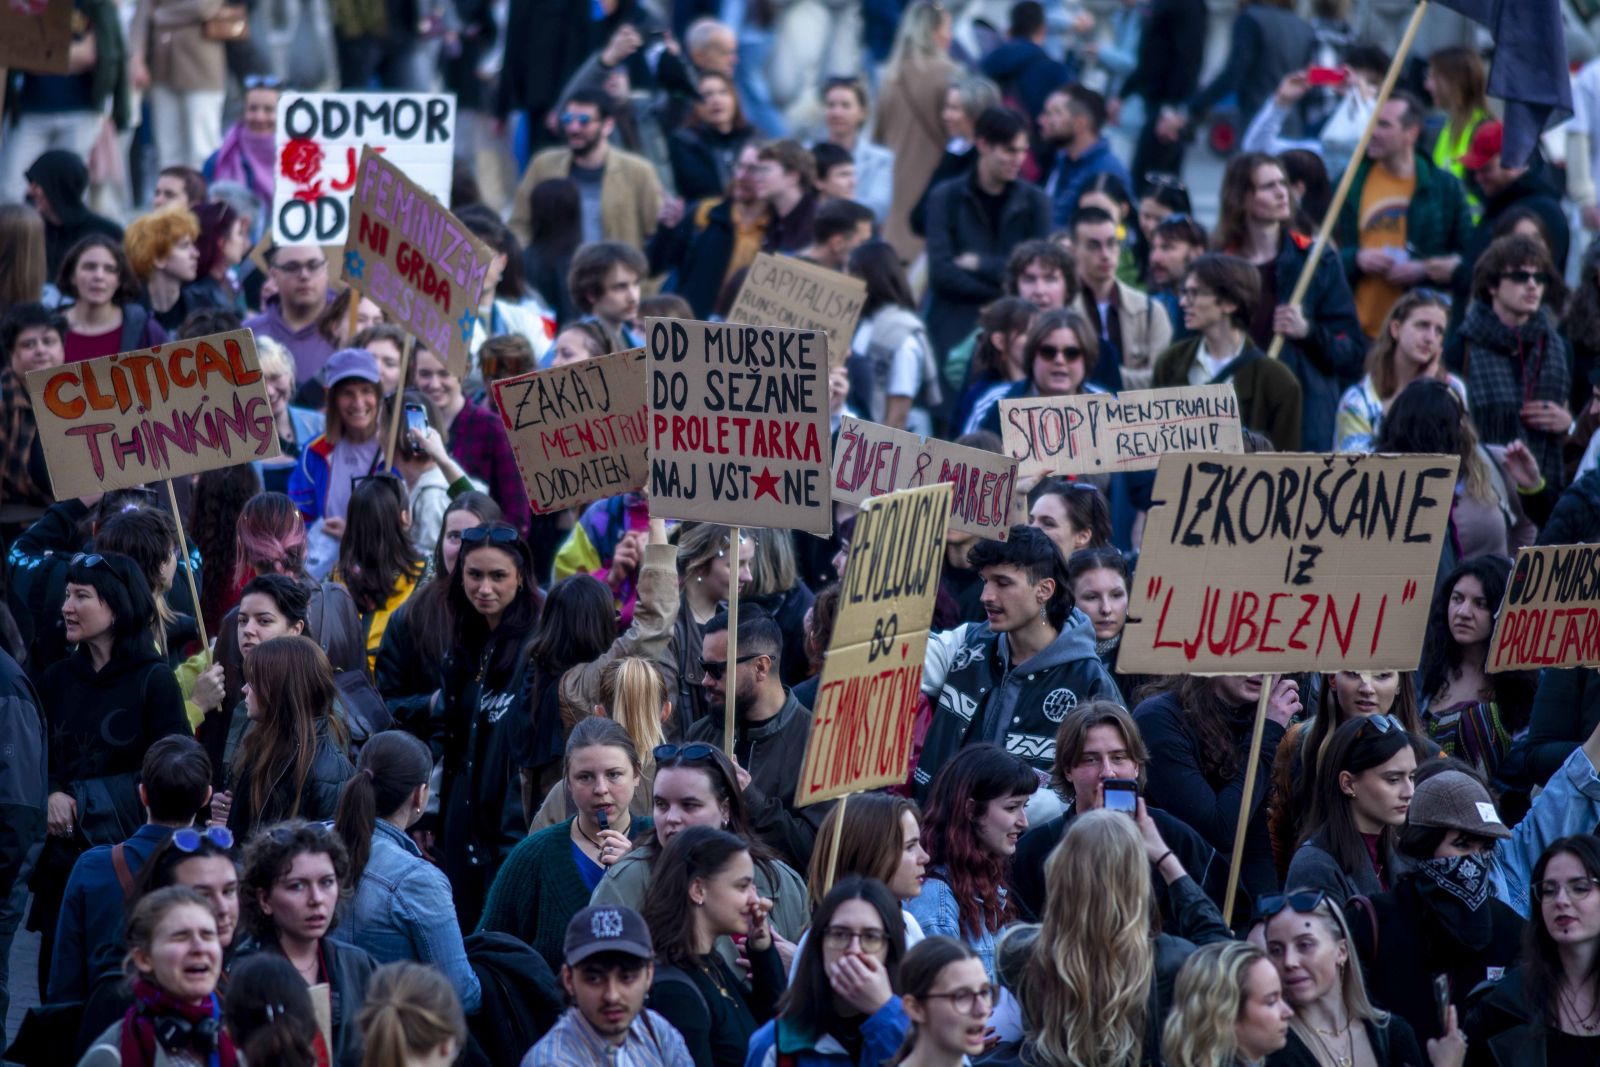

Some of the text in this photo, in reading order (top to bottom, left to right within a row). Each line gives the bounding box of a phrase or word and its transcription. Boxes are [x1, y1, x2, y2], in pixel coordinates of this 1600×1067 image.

[284, 97, 451, 144] ODMOR
[331, 146, 387, 192] J
[360, 157, 489, 305] FEMINIZEM
[358, 212, 452, 314] NI GRDA
[370, 262, 452, 359] BESEDA
[741, 289, 777, 317] RUNS
[750, 260, 860, 325] CAPITALISM
[651, 321, 817, 370] OD MURSKE
[43, 338, 262, 420] CLITICAL
[505, 362, 610, 431] ZAKAJ
[653, 367, 818, 415] DO SEŽANE
[65, 391, 273, 482] THINKING
[1008, 400, 1102, 466] STOP!
[1106, 396, 1238, 424] MENSTRUALNI
[653, 414, 822, 464] PROLETARKA
[534, 454, 631, 508] DODATEN
[652, 458, 697, 500] NAJ
[1170, 454, 1454, 547] IZKORIŠČANE
[840, 490, 950, 611] REVOLUCIJA
[1283, 544, 1324, 586] IZ
[1508, 550, 1544, 605] OD
[867, 612, 898, 663] BO
[799, 642, 924, 802] FEMINISTIČNA
